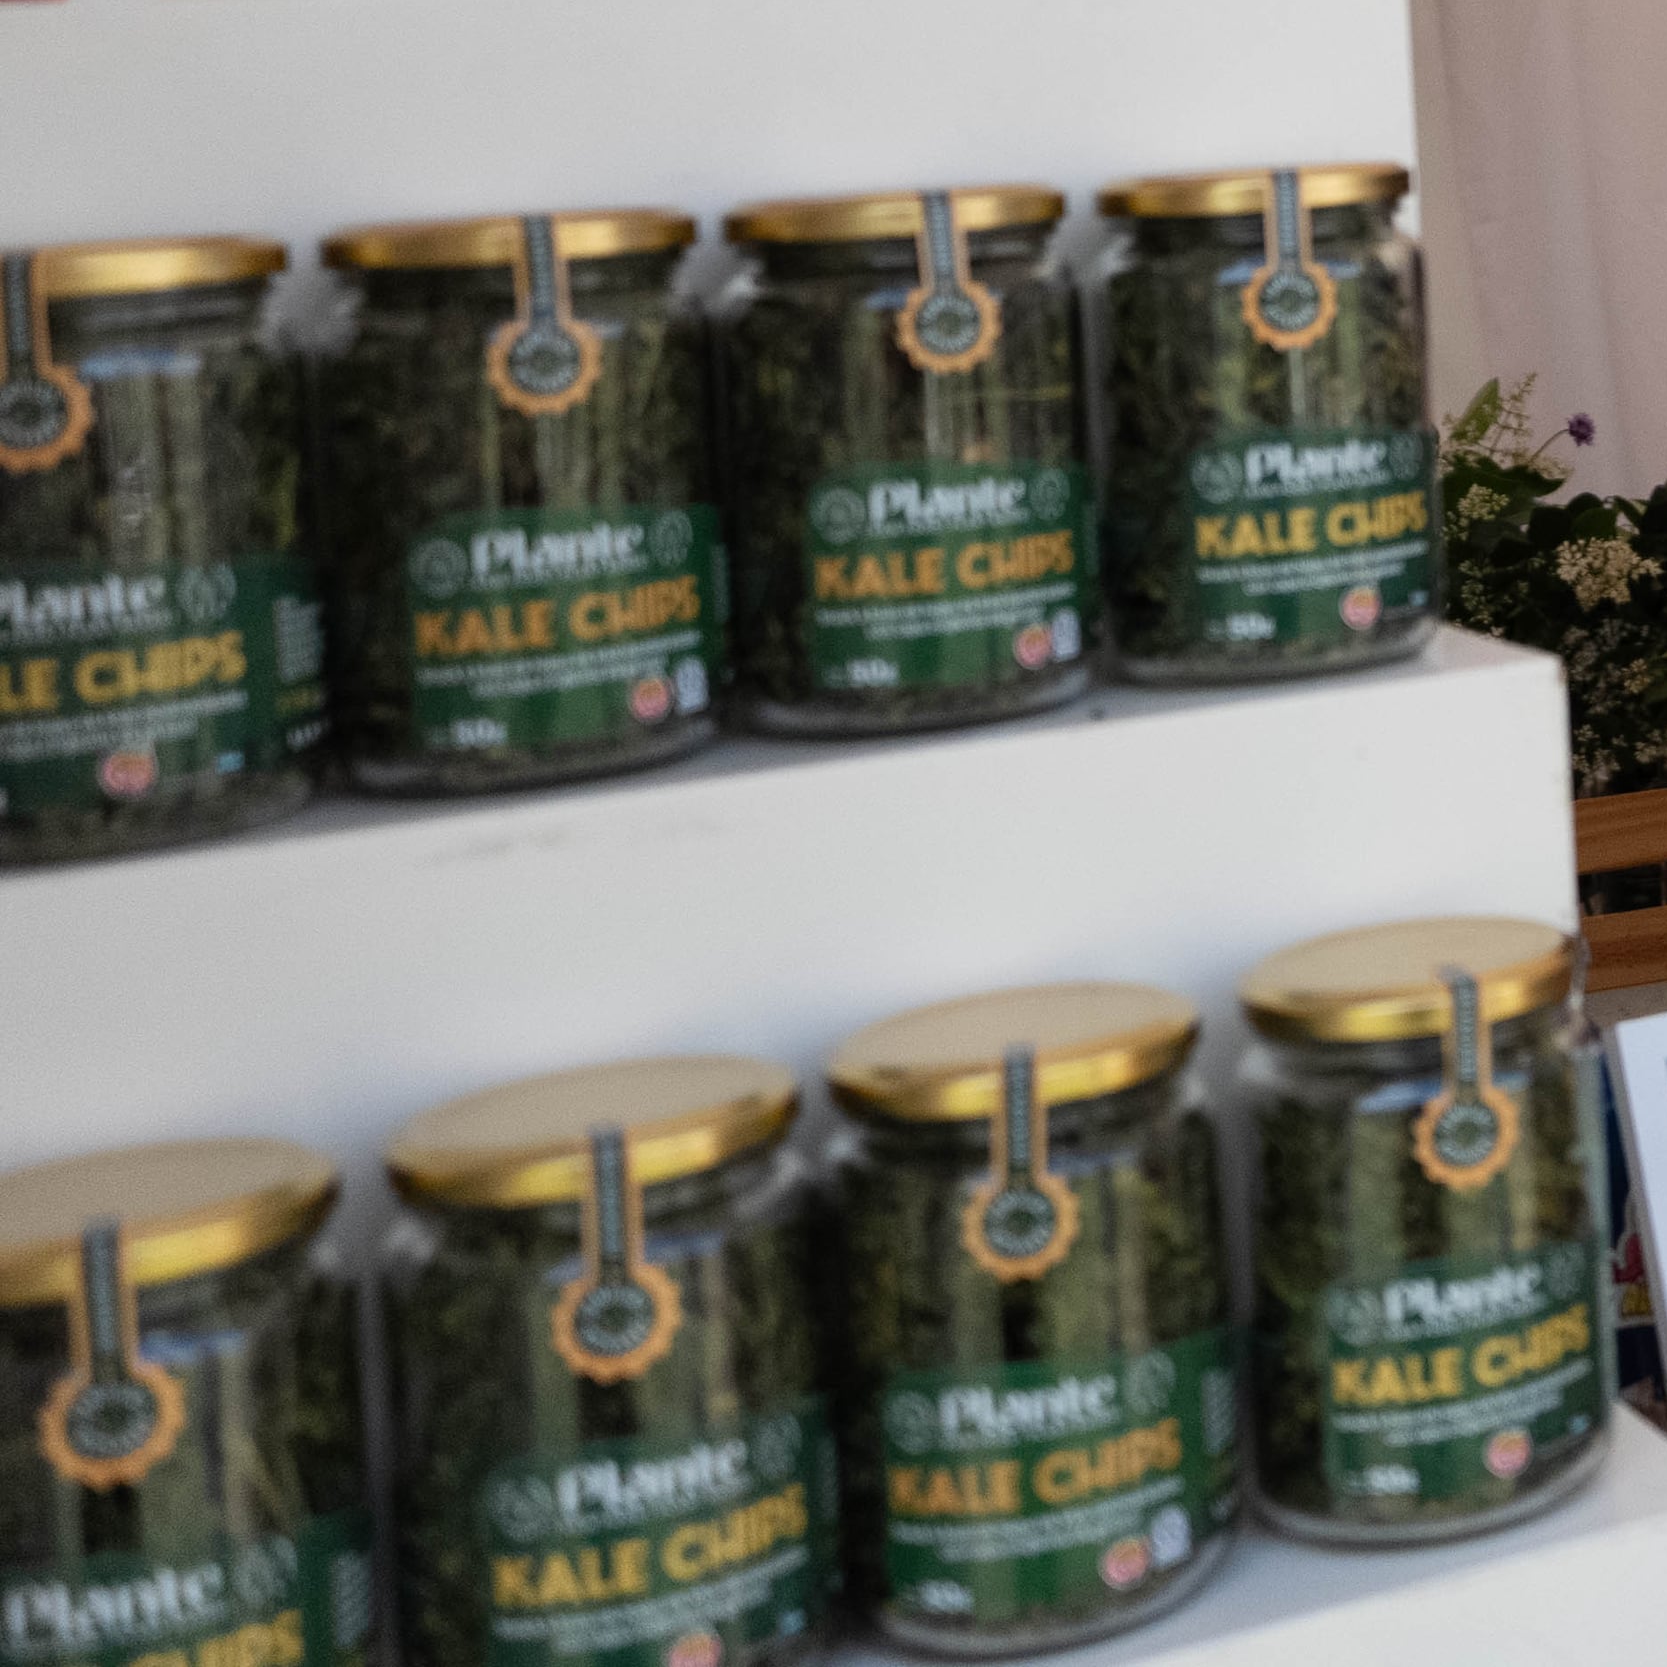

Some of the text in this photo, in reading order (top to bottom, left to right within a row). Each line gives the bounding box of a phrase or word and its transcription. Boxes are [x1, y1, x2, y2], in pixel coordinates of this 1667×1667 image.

[1244, 440, 1388, 485] Plante
[869, 476, 1027, 532] Plante
[1195, 490, 1428, 558] KALE CHIPS
[472, 523, 645, 584] Plante
[815, 530, 1074, 601] KALE CHIPS
[413, 576, 703, 658] KALE CHIPS
[75, 631, 248, 704] CHIPS
[1331, 1347, 1464, 1406] KALE
[1471, 1303, 1590, 1388] CHIPS
[889, 1418, 1184, 1515] KALE CHIPS
[492, 1541, 651, 1608] KALE
[662, 1483, 808, 1584] CHIPS
